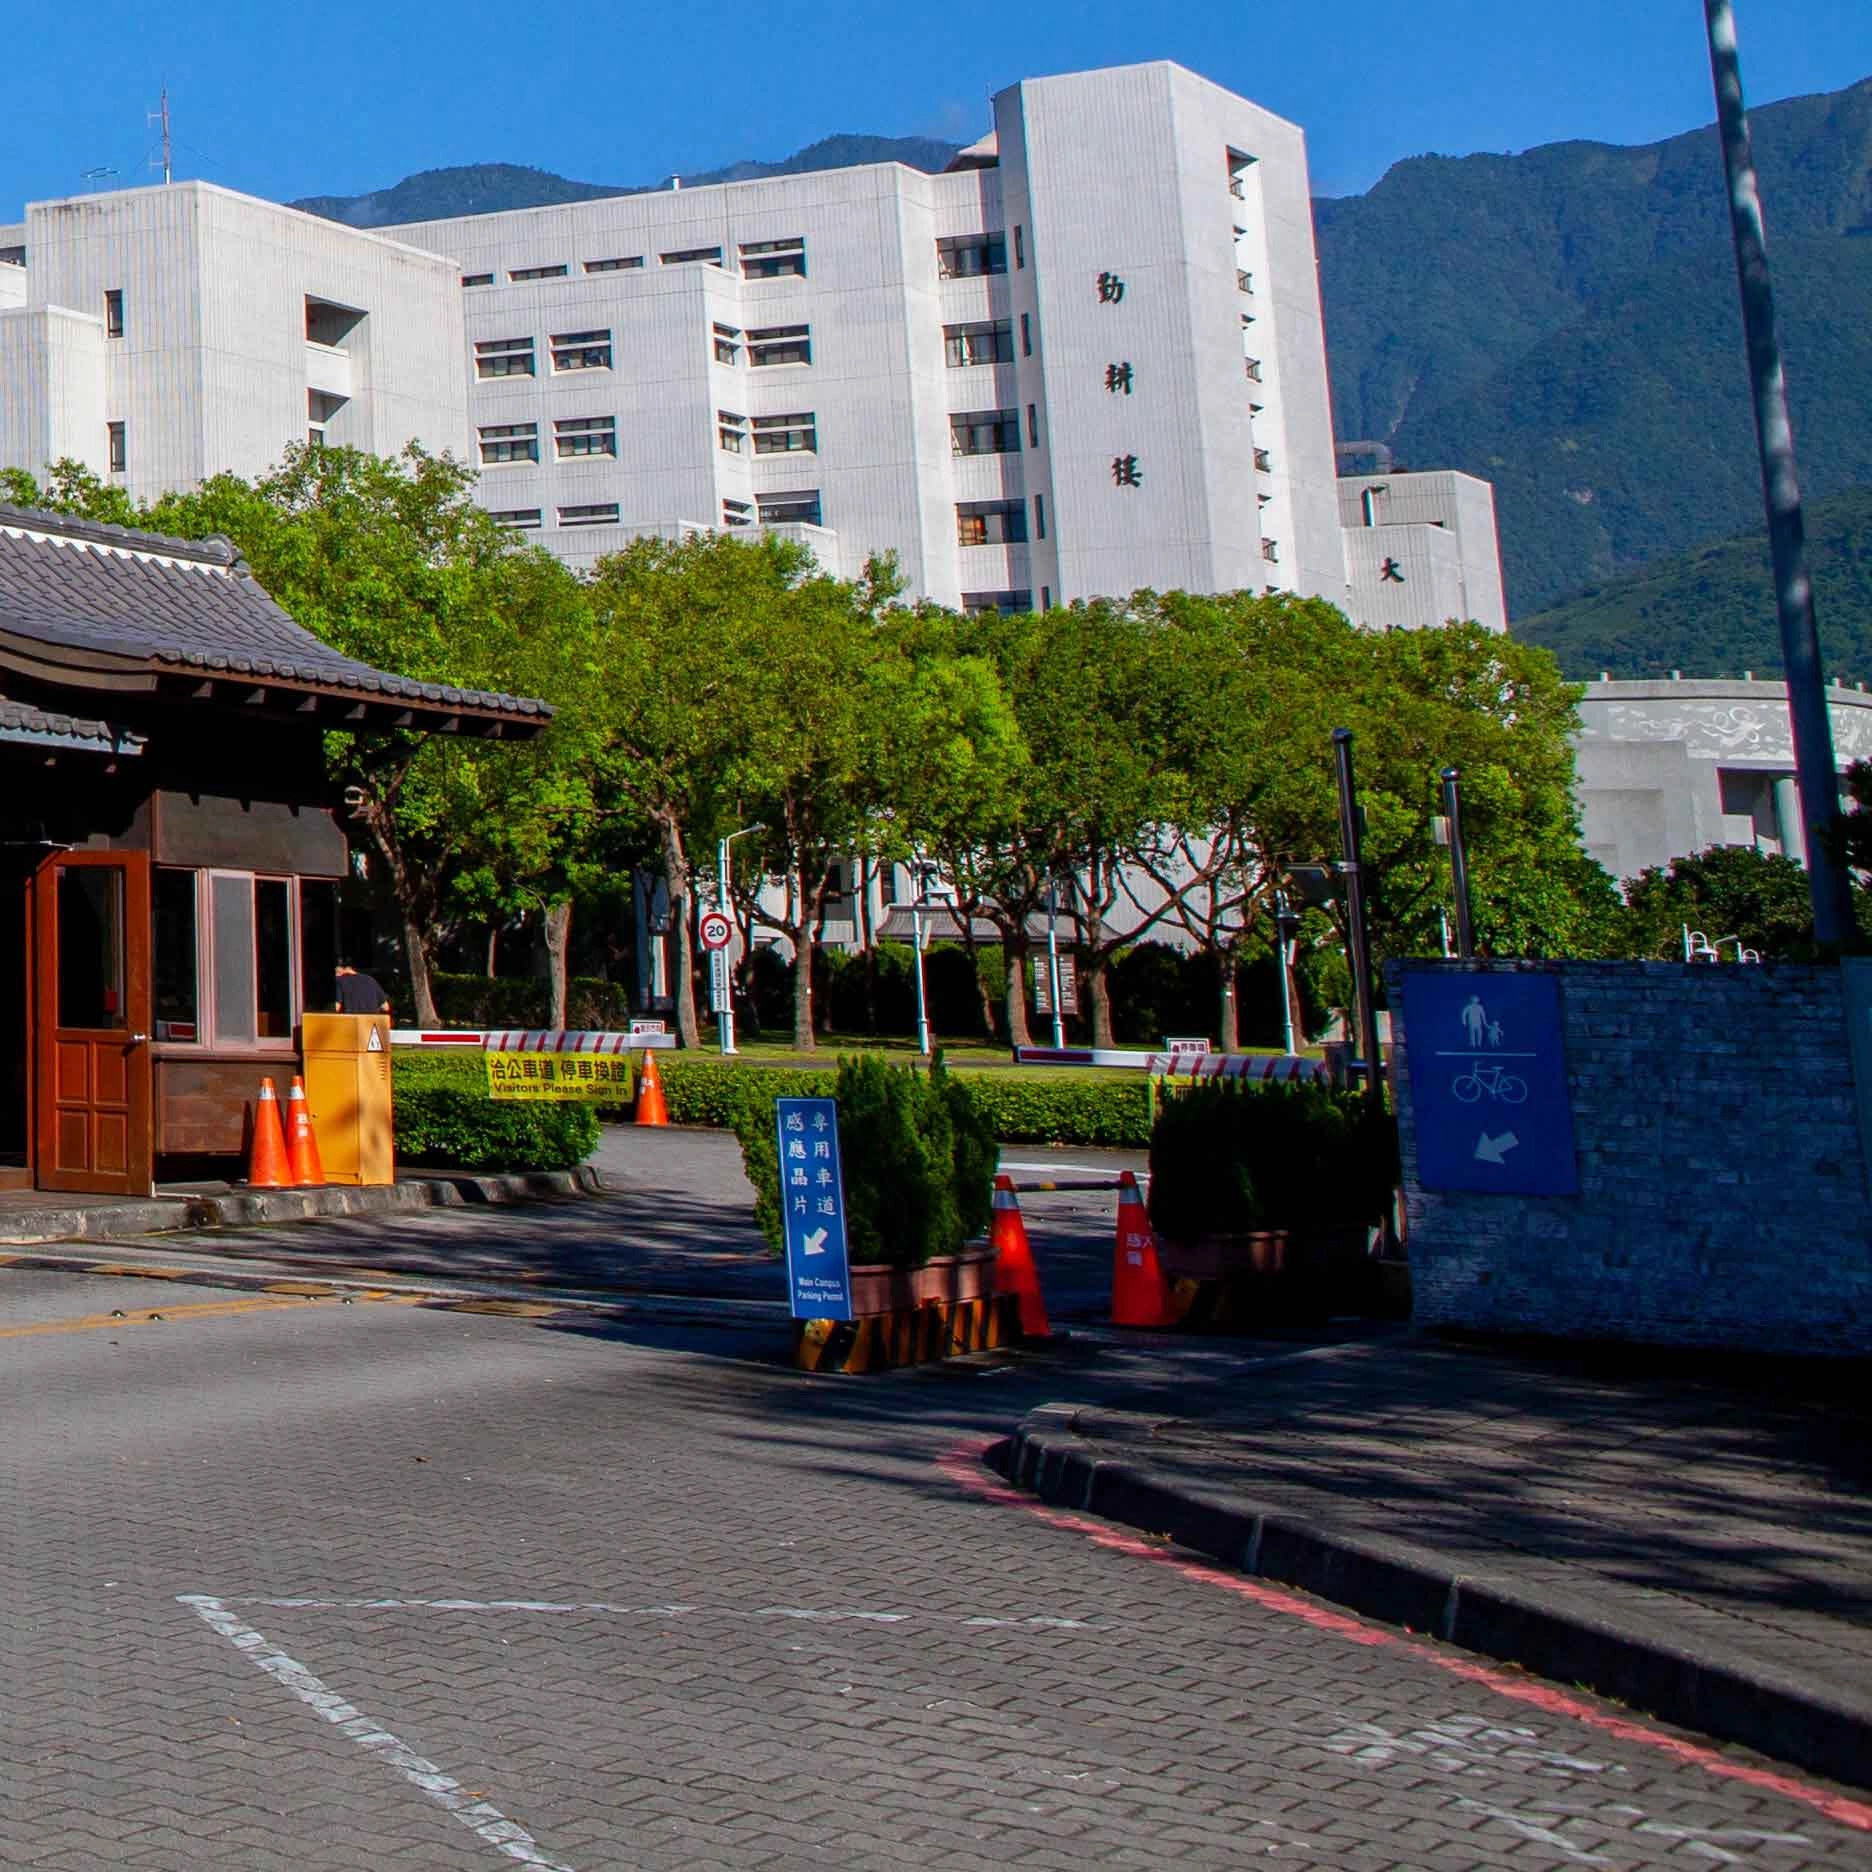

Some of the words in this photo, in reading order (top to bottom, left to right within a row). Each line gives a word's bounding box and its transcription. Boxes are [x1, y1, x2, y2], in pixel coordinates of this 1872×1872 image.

[1096, 270, 1144, 489] 勤耕樓
[707, 925, 726, 937] 20
[490, 1058, 555, 1080] 洽公車道
[560, 1059, 627, 1082] 停車換證
[494, 1082, 539, 1094] Visitors
[543, 1083, 582, 1095] Please
[586, 1084, 611, 1096] Sign
[615, 1085, 628, 1096] In
[785, 1111, 809, 1215] 感應晶片
[811, 1111, 837, 1216] 專用車道
[798, 1289, 822, 1303] Parking
[823, 1290, 844, 1301] Permit
